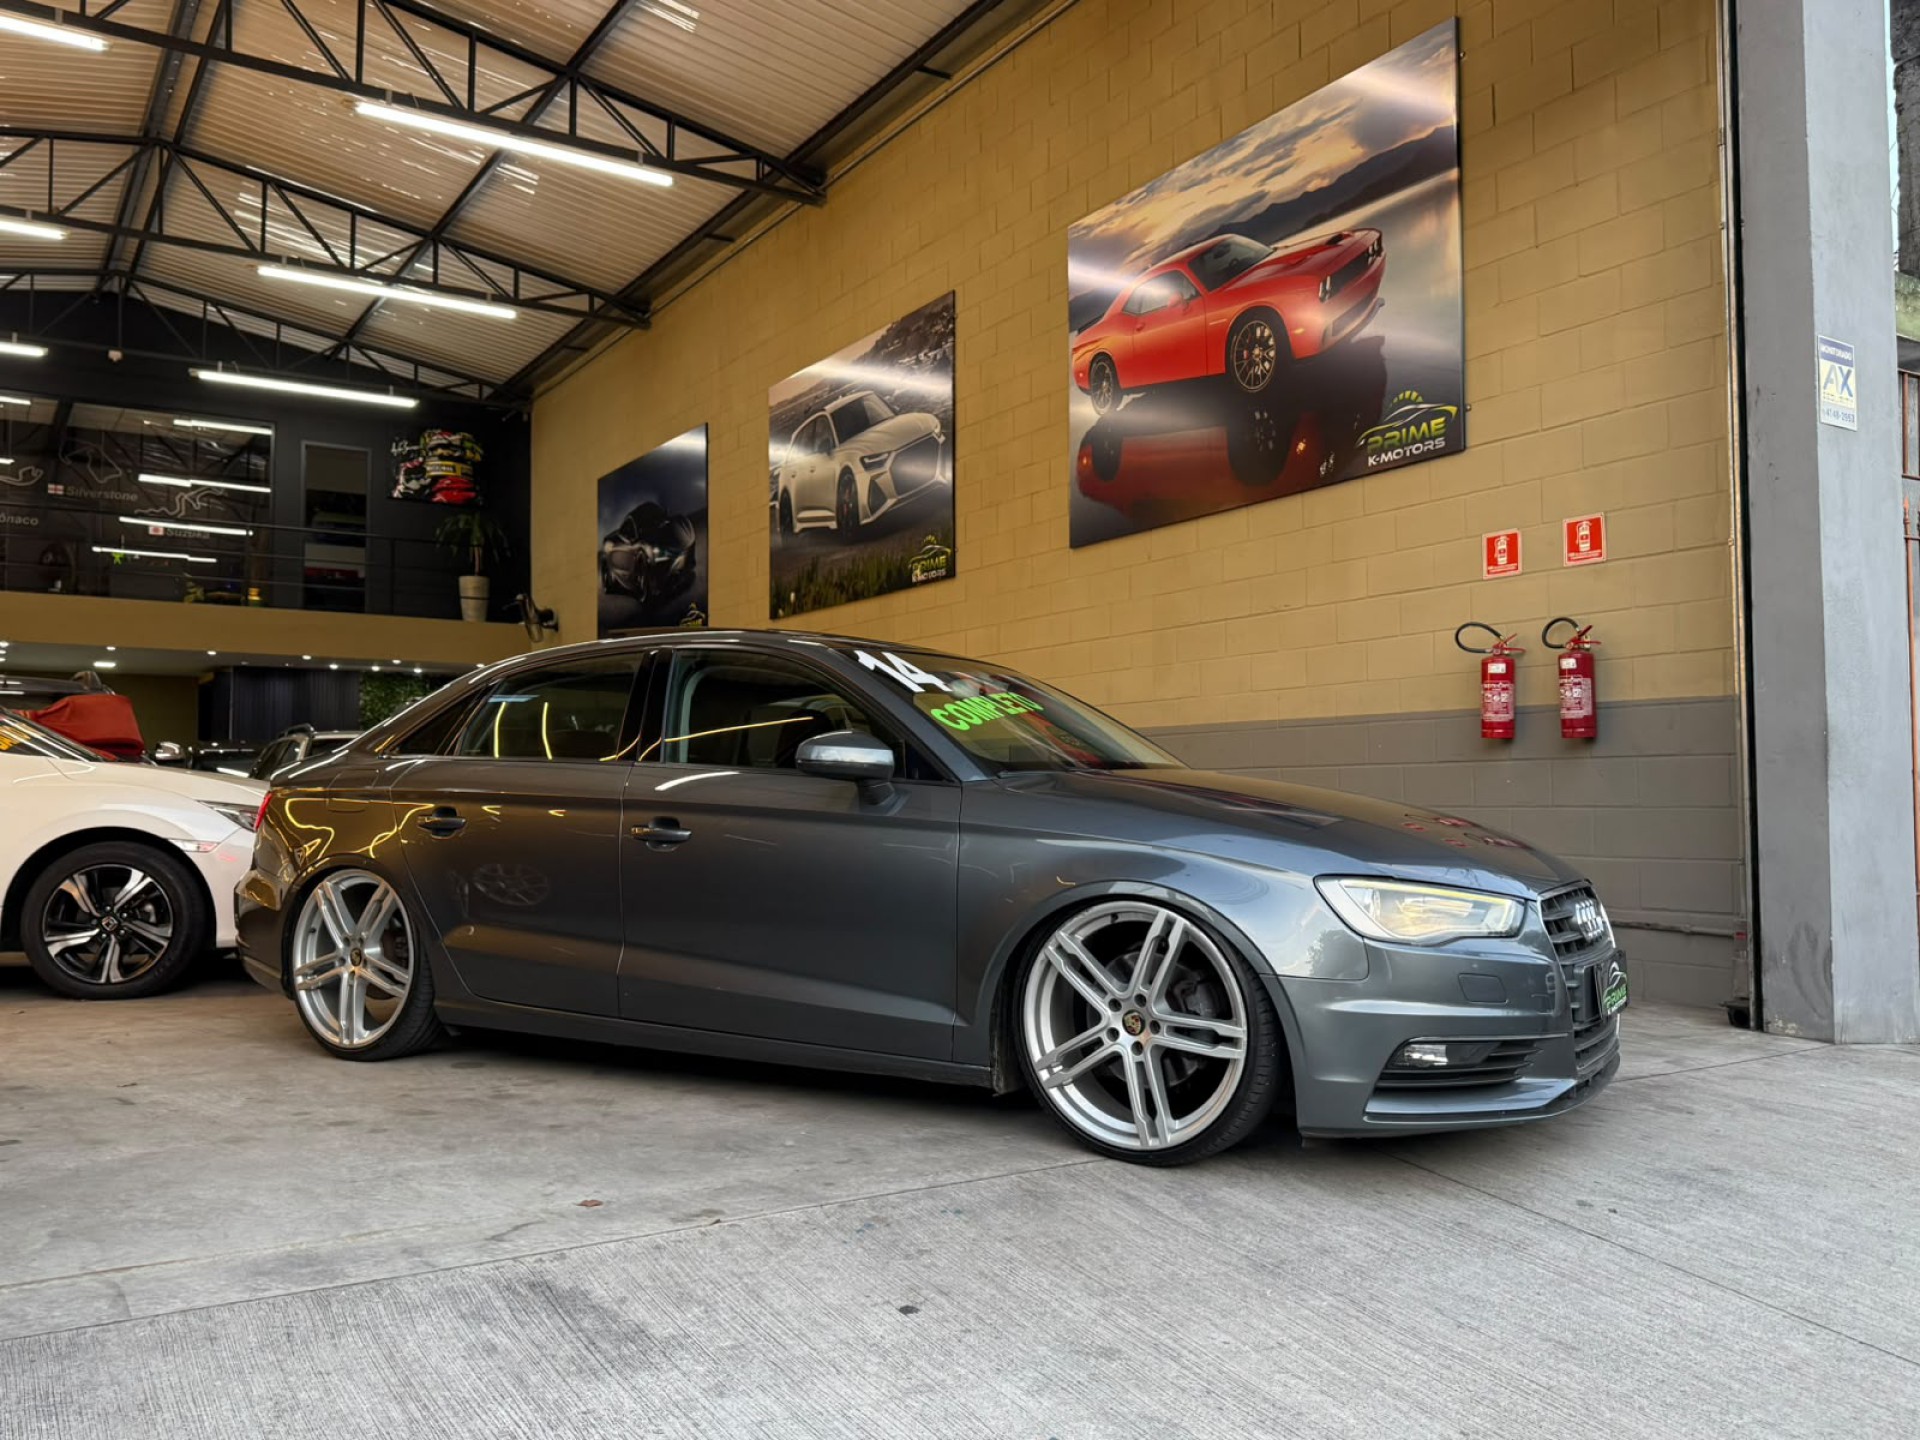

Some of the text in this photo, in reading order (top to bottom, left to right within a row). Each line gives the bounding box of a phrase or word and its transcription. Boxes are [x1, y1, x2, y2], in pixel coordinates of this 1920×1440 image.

[1823, 364, 1854, 398] AX
[1367, 416, 1447, 454] PRIME
[1367, 436, 1446, 467] K-MOTORS
[66, 485, 139, 502] Silverstone
[854, 650, 953, 693] 14
[930, 691, 1045, 732] COMPLETO
